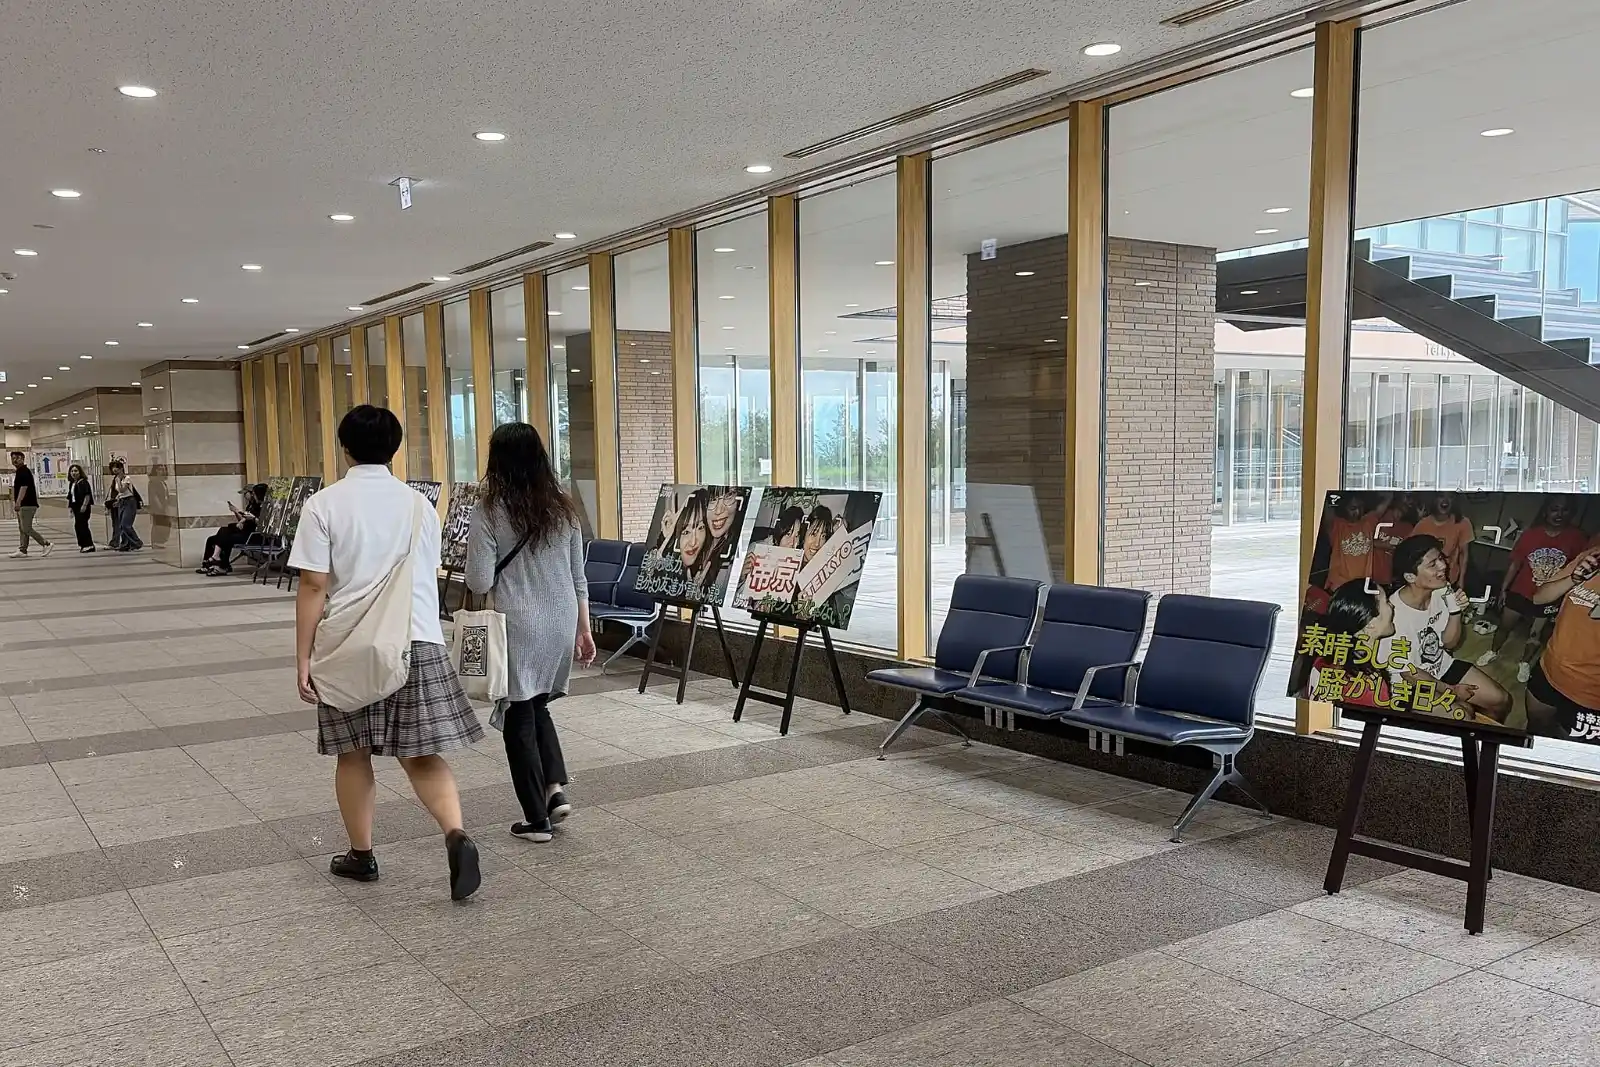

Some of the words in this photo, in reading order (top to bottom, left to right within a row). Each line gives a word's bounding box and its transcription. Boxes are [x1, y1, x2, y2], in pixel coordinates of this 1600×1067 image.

[1298, 623, 1417, 675] 素晴らしき、
[1314, 667, 1465, 720] 騒がしき日々。
